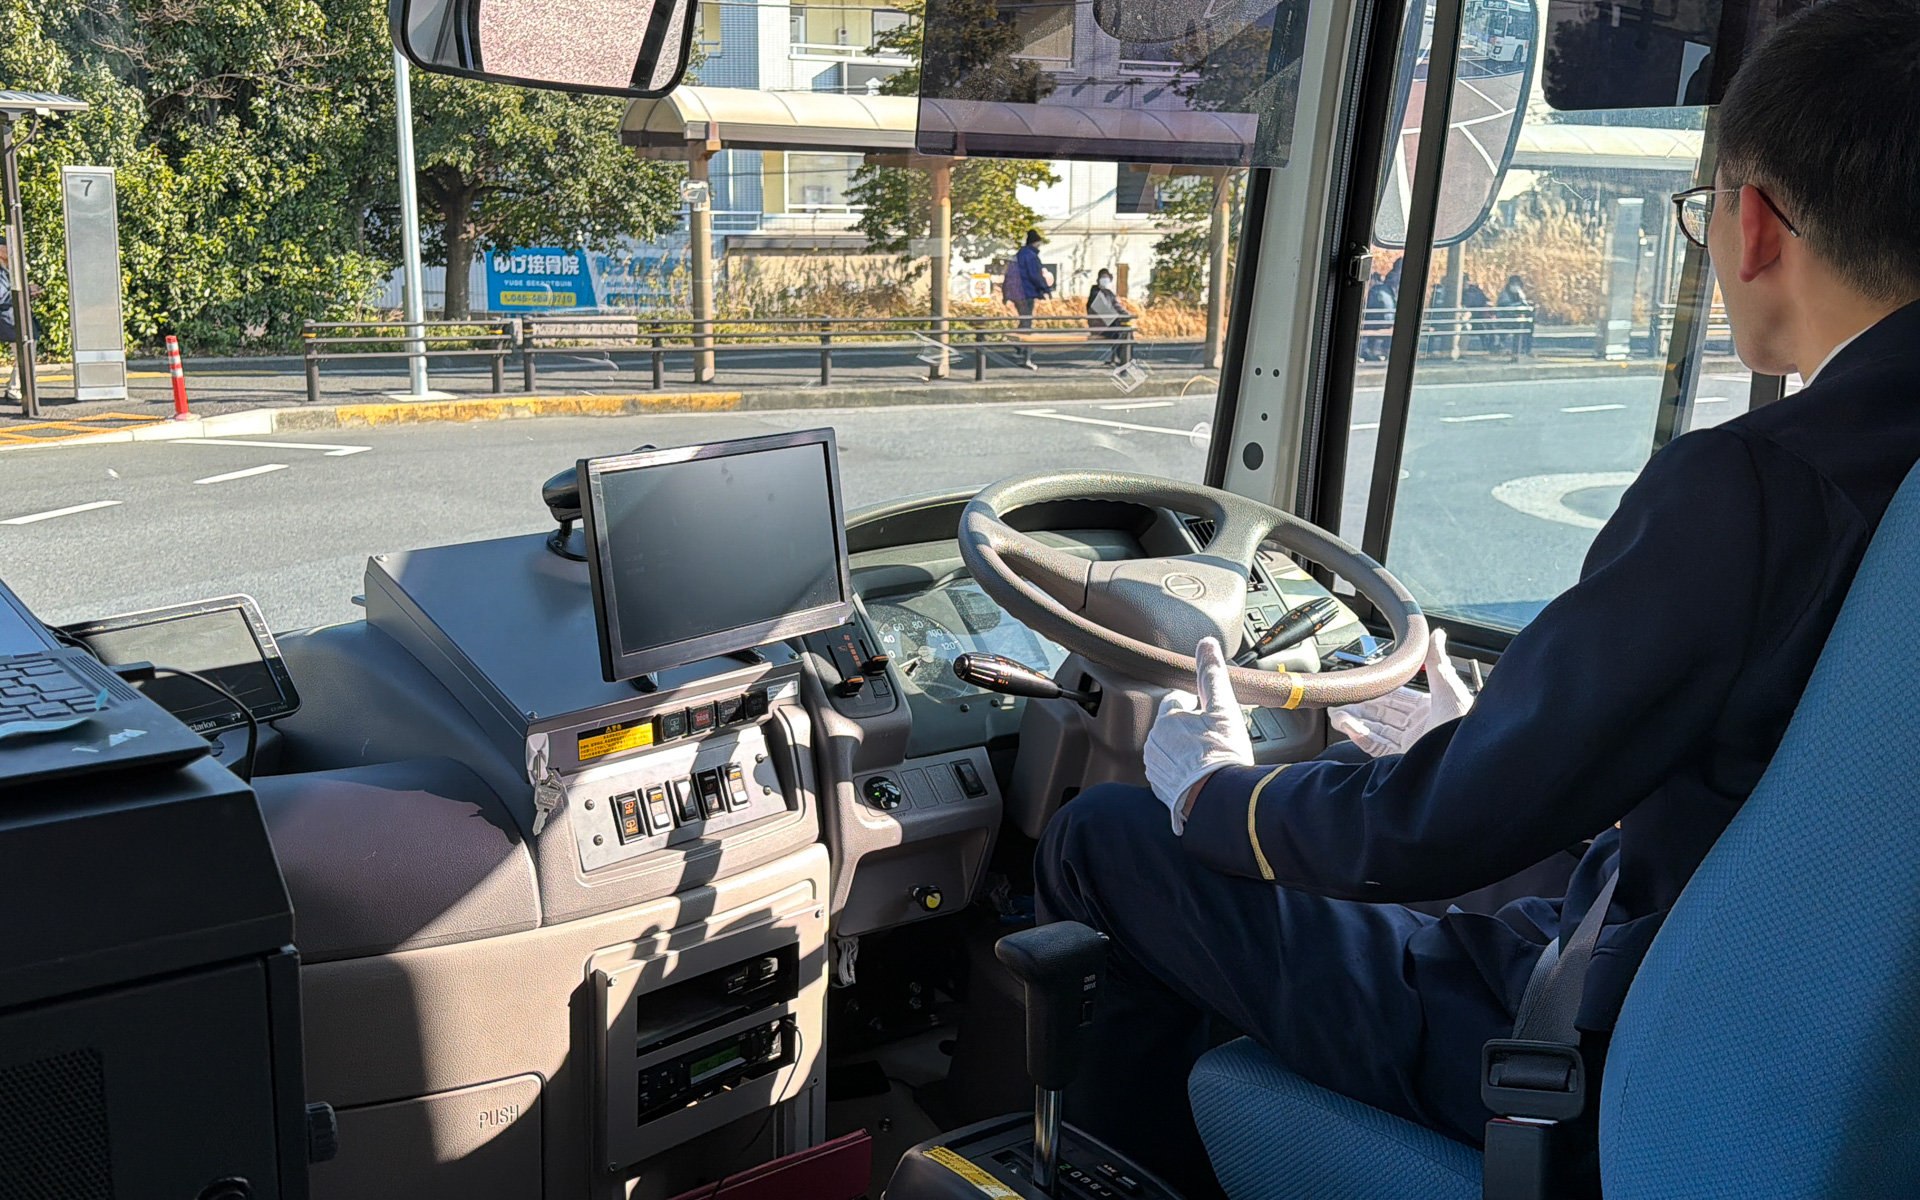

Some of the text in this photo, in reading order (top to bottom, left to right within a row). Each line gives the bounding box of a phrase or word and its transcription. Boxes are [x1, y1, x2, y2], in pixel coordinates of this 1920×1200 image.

[80, 179, 93, 197] 7
[493, 254, 580, 275] ゆげ接骨院
[893, 622, 905, 632] 60
[911, 620, 924, 630] 80
[928, 629, 944, 638] 100
[883, 634, 896, 644] 40
[941, 641, 956, 651] 120
[479, 1104, 519, 1129] PUSH
